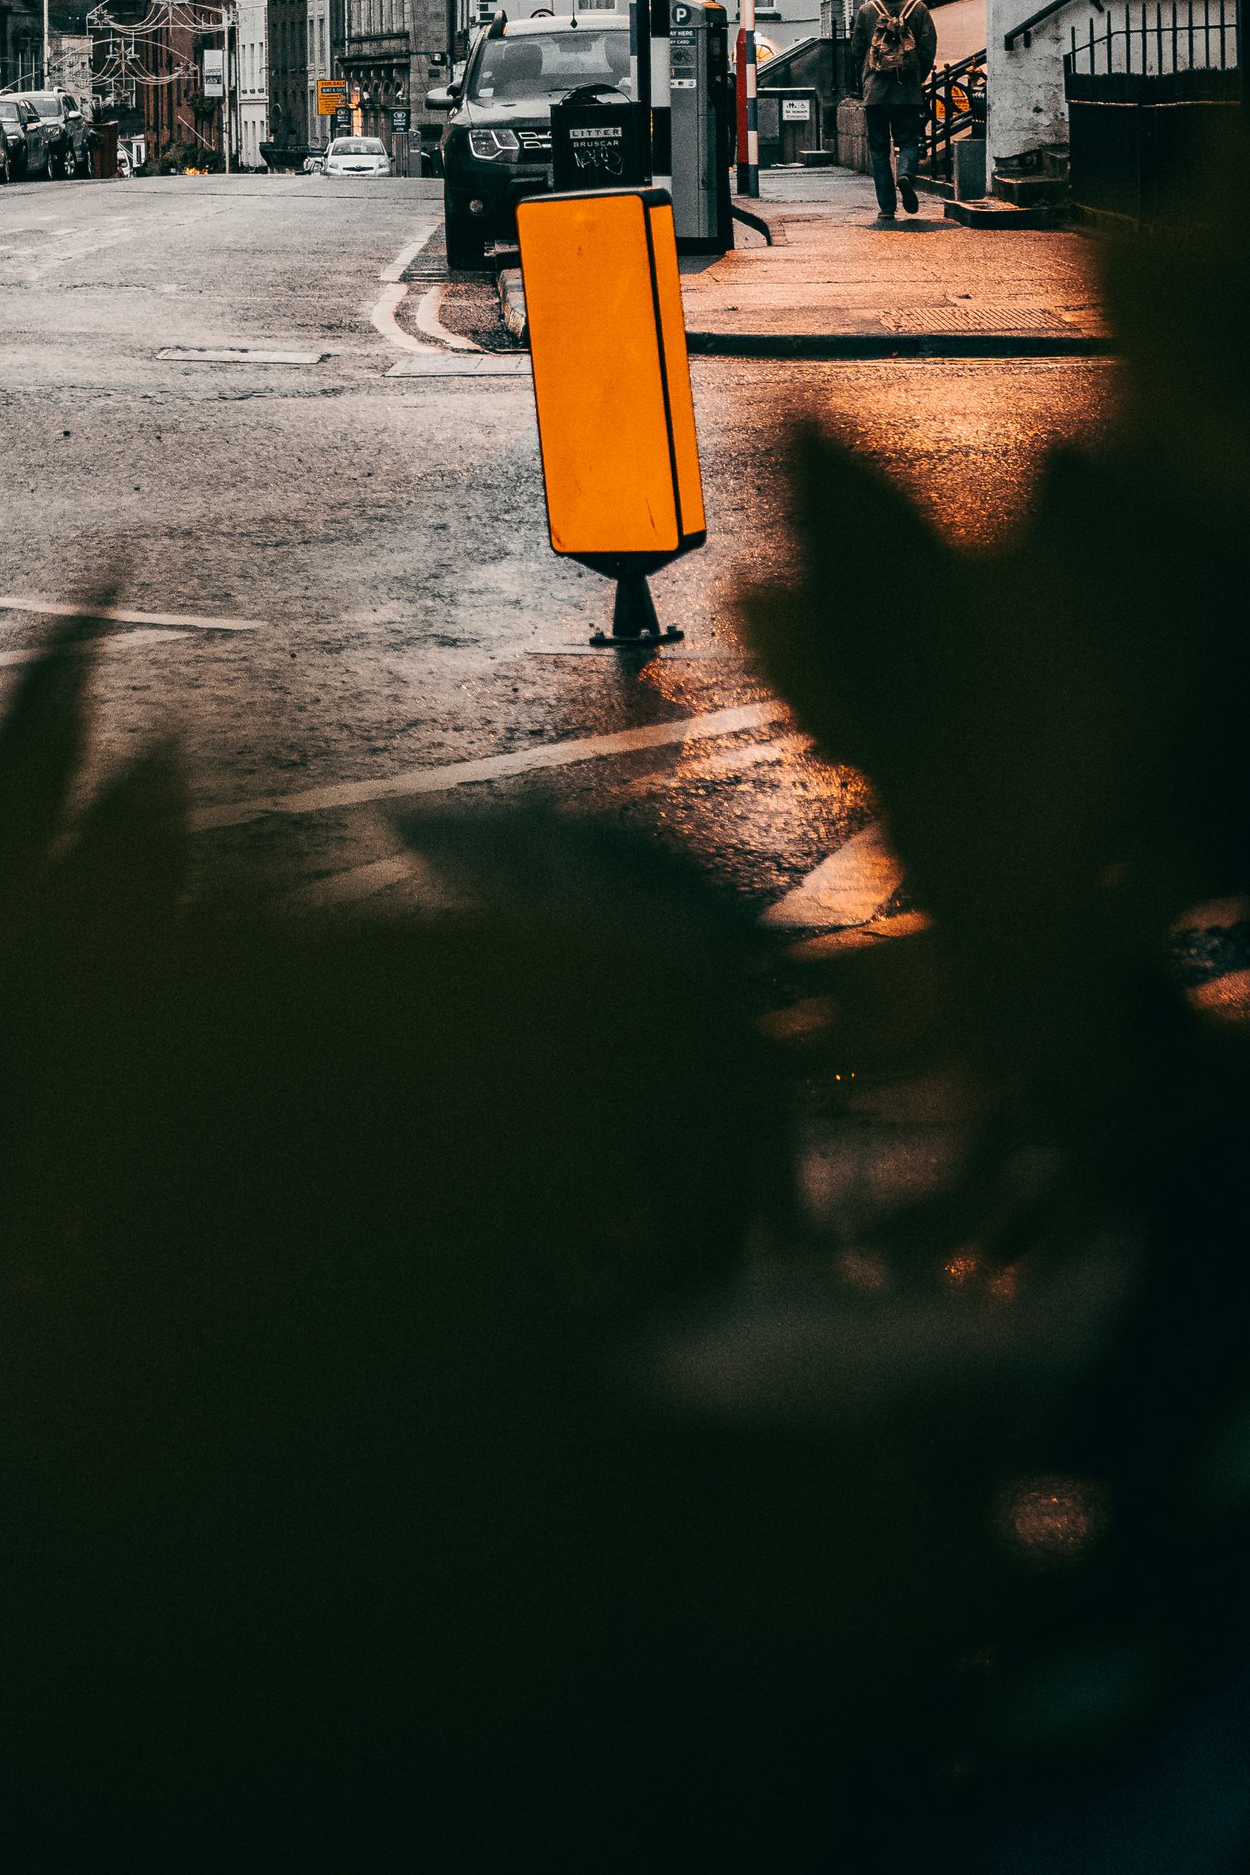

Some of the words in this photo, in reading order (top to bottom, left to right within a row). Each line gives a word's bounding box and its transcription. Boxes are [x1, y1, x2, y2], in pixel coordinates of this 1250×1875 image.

[676, 8, 687, 22] P
[572, 129, 620, 137] LITTER
[573, 140, 619, 148] BRUSCAR
